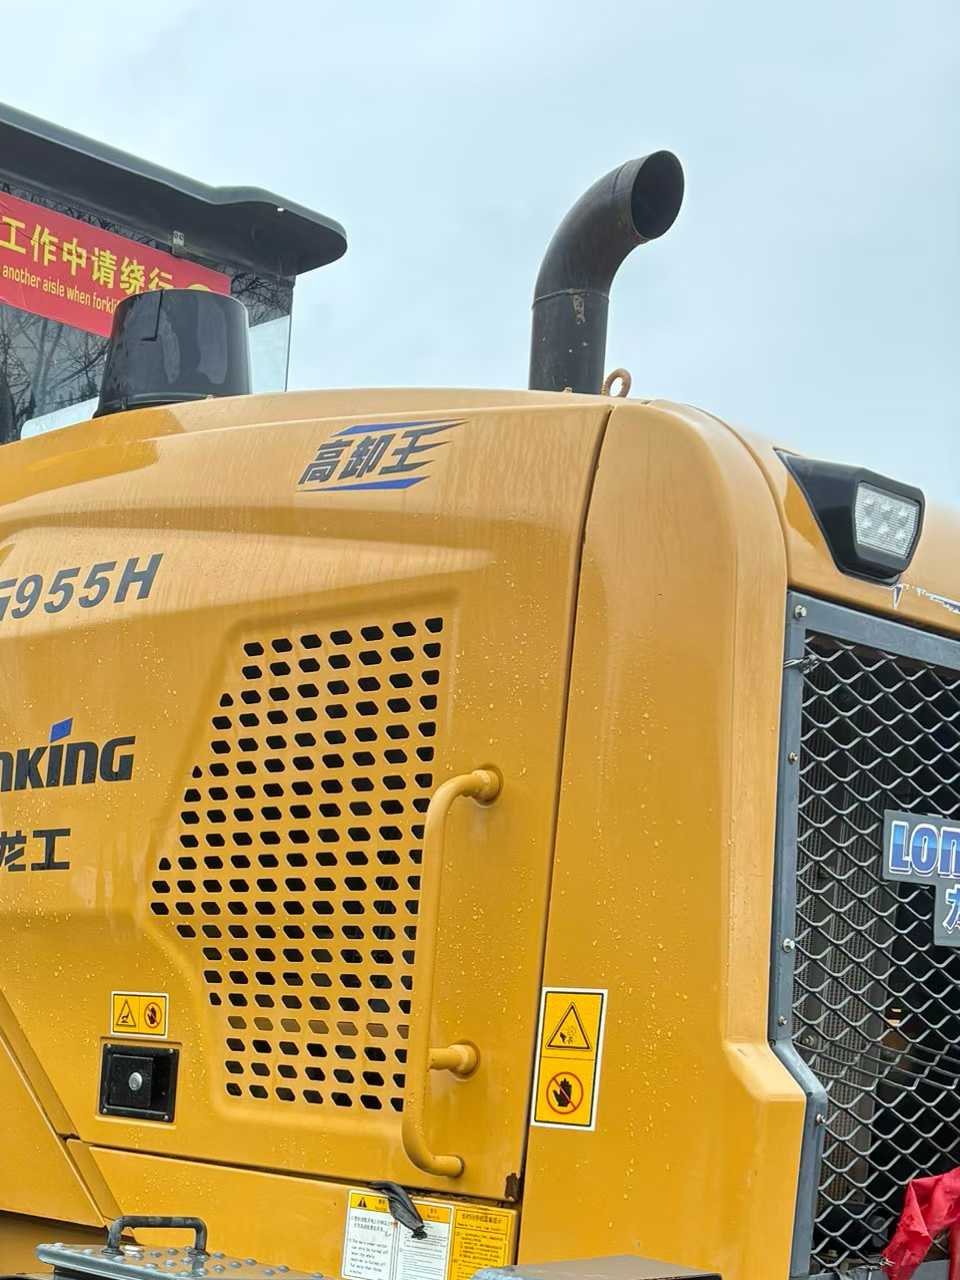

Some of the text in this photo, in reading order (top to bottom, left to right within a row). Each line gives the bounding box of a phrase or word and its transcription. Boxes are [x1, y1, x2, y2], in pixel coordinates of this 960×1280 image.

[2, 265, 41, 288] another
[42, 276, 65, 297] aisle
[66, 286, 91, 306] when
[297, 420, 470, 485] 高卸王
